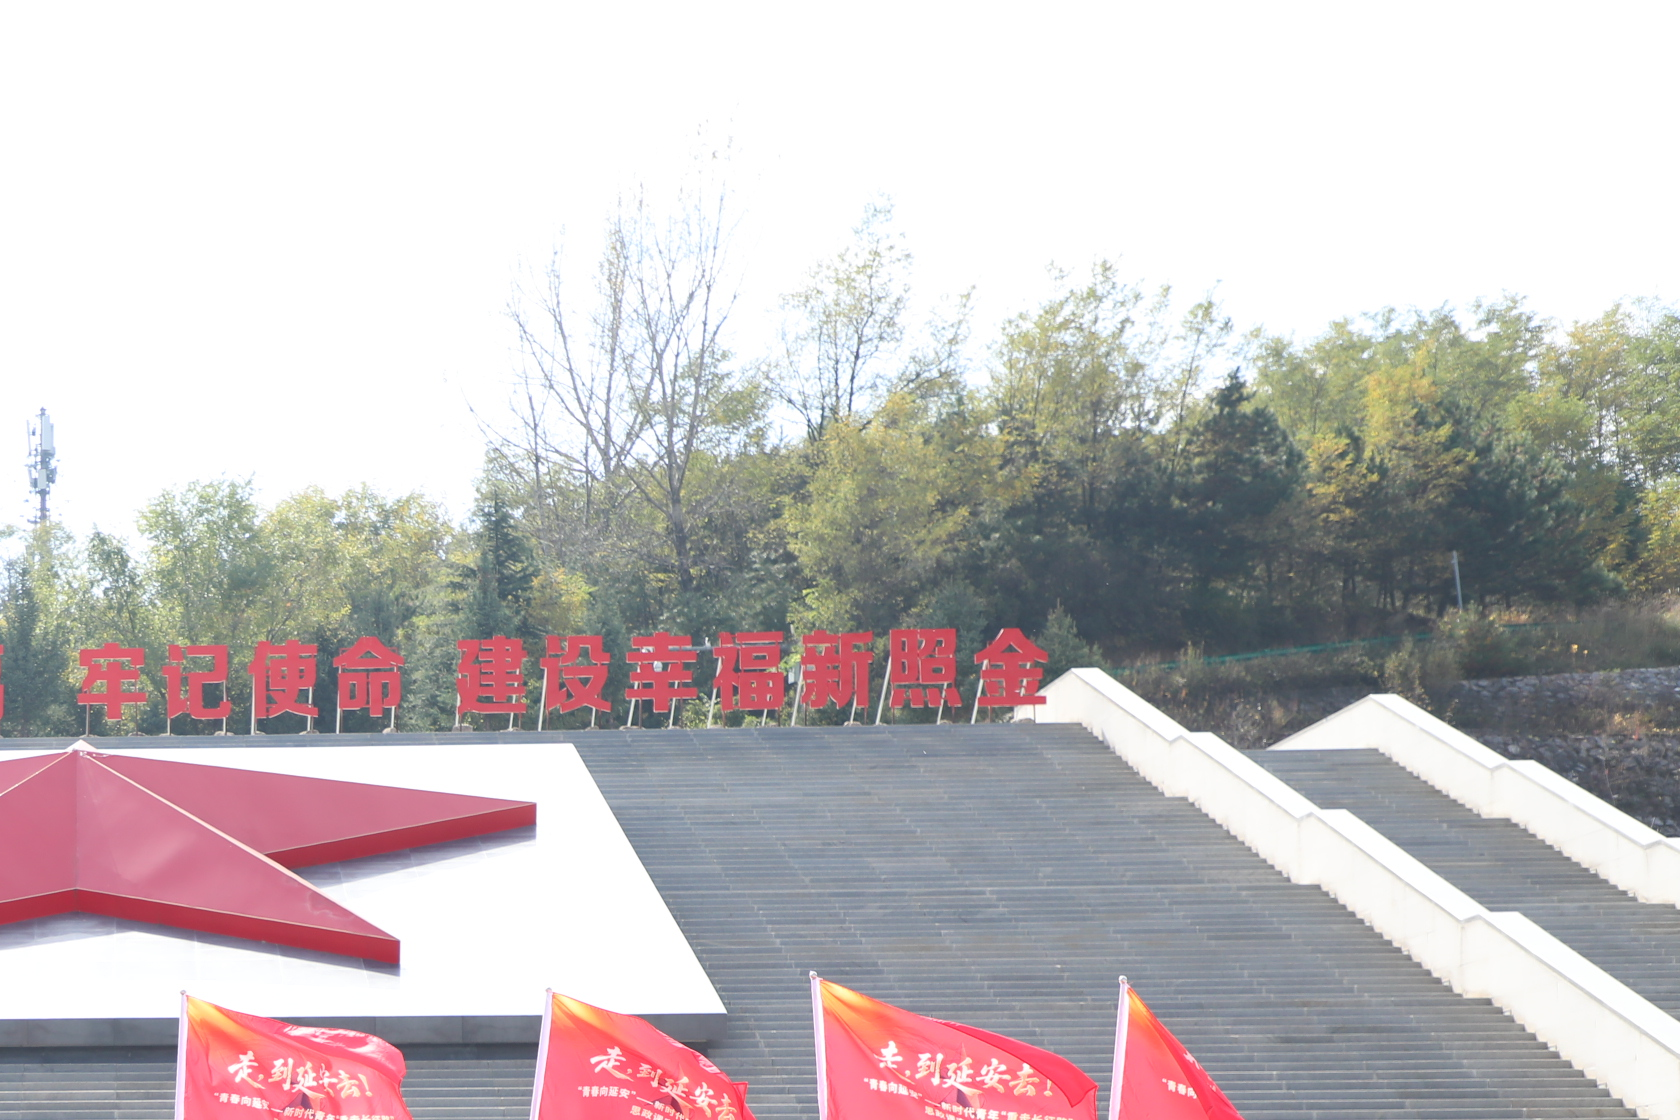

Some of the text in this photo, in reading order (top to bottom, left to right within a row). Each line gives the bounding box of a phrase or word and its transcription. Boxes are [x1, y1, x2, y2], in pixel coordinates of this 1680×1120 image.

[77, 635, 402, 721] 牢记使命
[456, 627, 1049, 714] 建设幸福新照金
